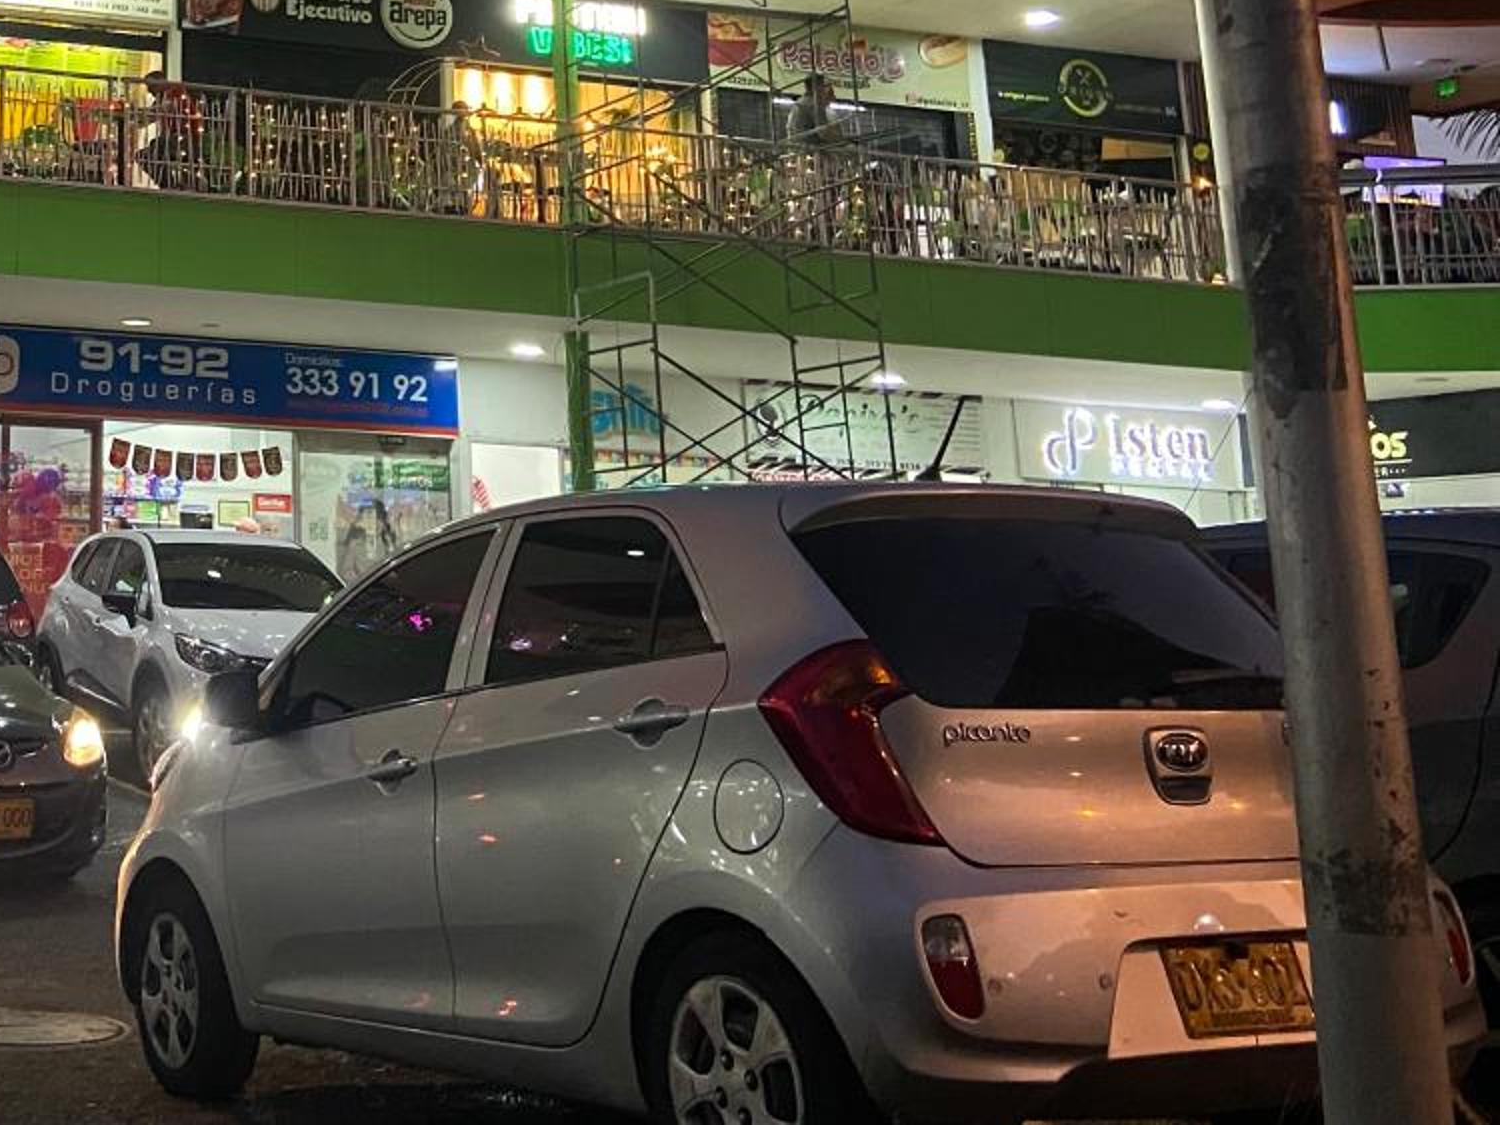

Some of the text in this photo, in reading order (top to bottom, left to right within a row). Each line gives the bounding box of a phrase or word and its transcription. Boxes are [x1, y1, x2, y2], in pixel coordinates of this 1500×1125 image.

[389, 0, 447, 30] arepa
[51, 372, 256, 405] Droguerías
[286, 367, 428, 402] 333 91 92
[1370, 430, 1409, 460] os
[942, 722, 1031, 747] picanto
